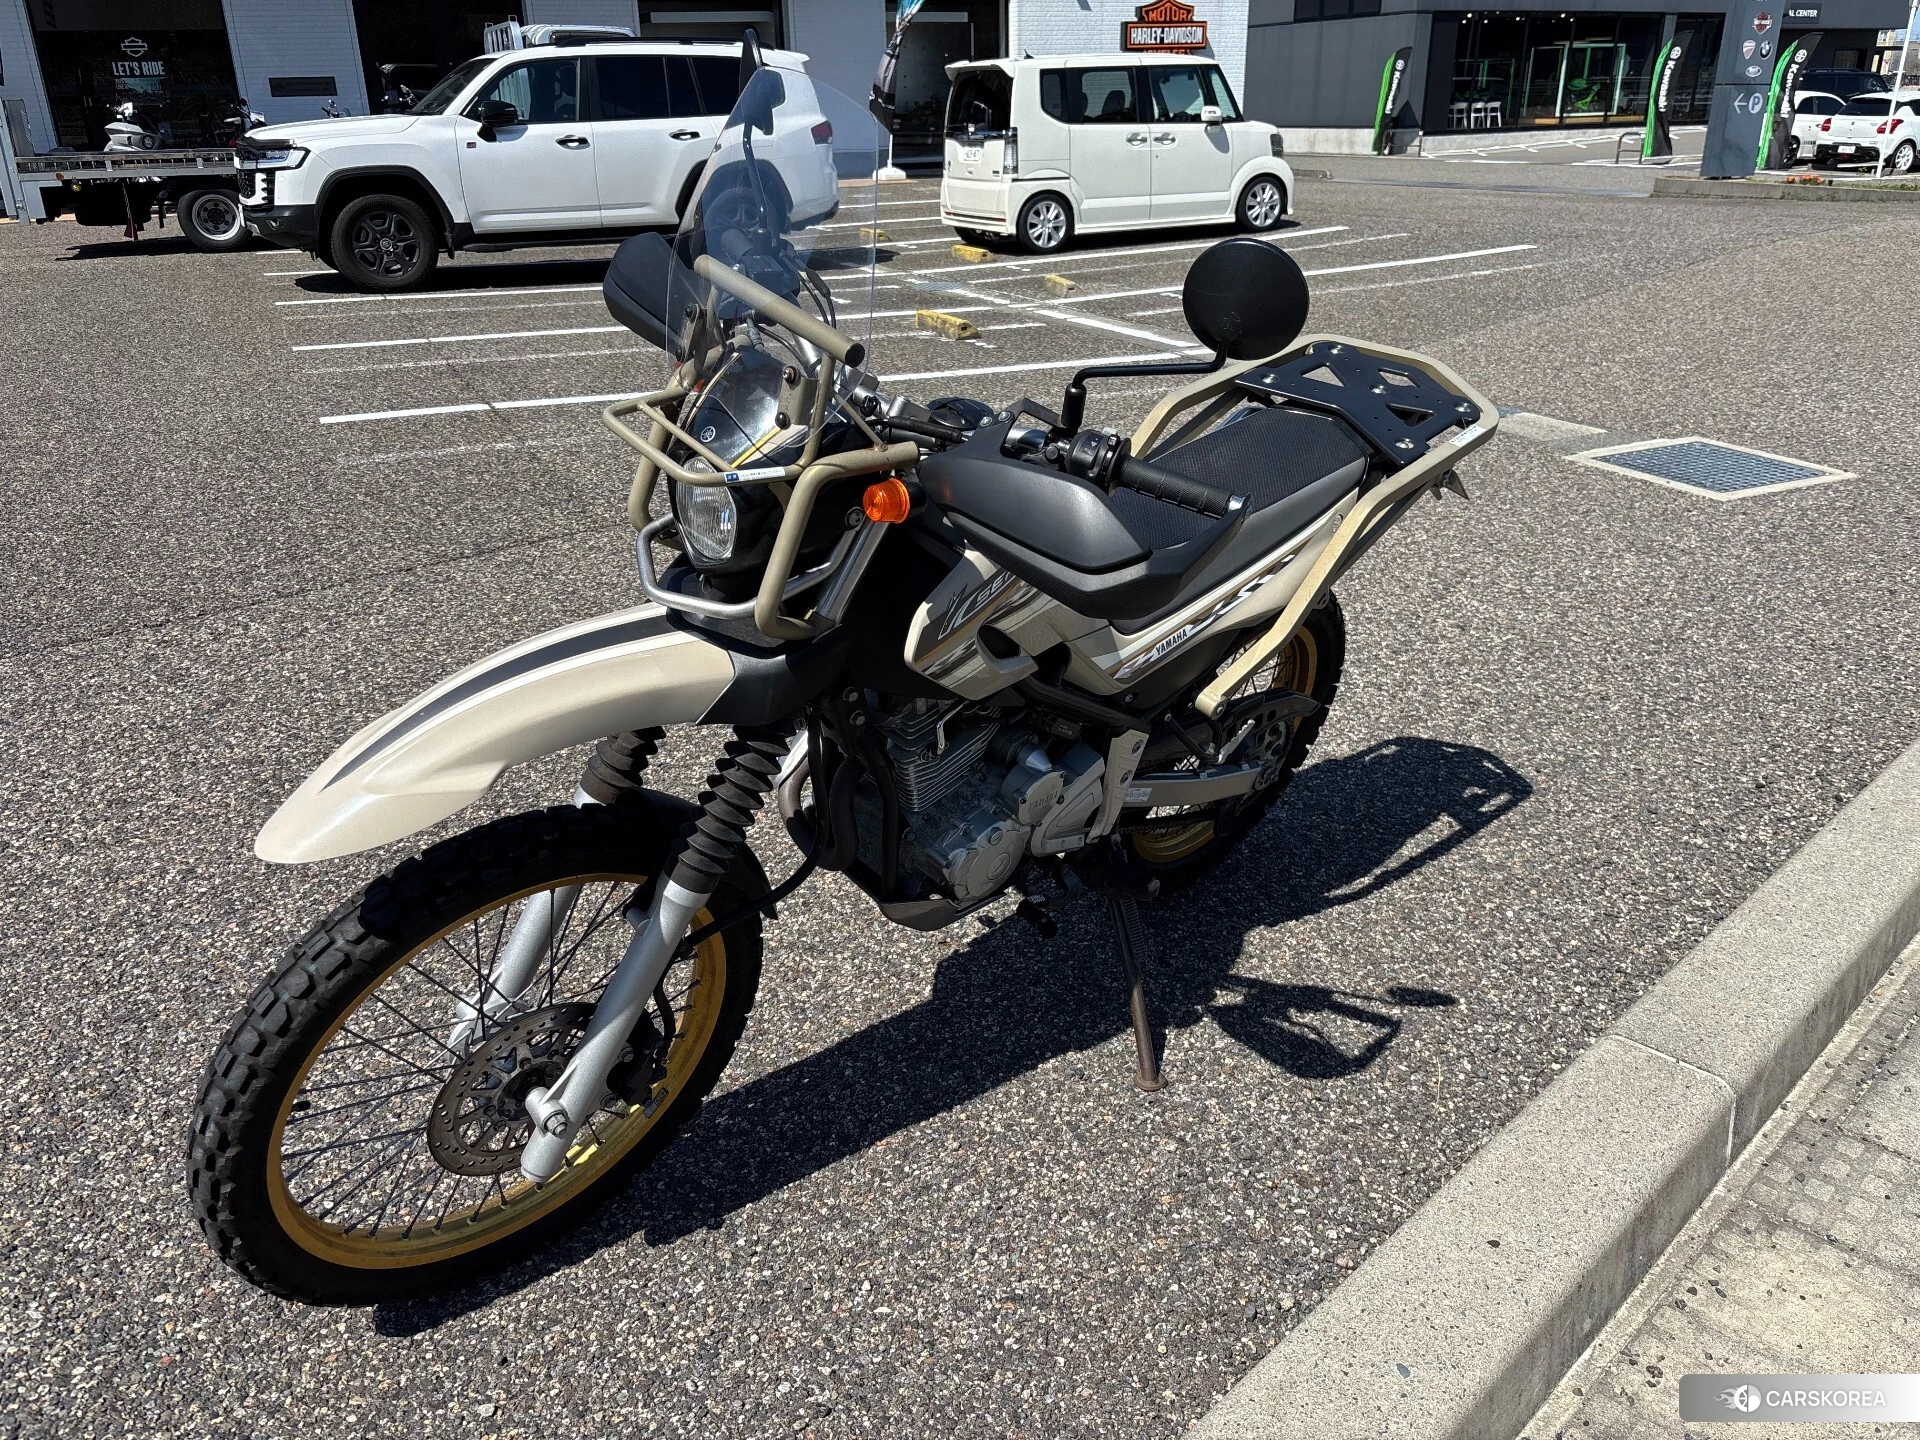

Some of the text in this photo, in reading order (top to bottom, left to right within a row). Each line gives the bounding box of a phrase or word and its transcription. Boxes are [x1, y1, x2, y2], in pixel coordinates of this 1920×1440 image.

[1148, 2, 1187, 21] MOTOR
[1796, 9, 1818, 18] CENTER
[1131, 27, 1203, 44] HARLEY-DAVIDSON
[111, 61, 166, 76] LET'S RIDE
[1658, 60, 1676, 112] Kawasaki
[1155, 628, 1188, 656] YAMAHA
